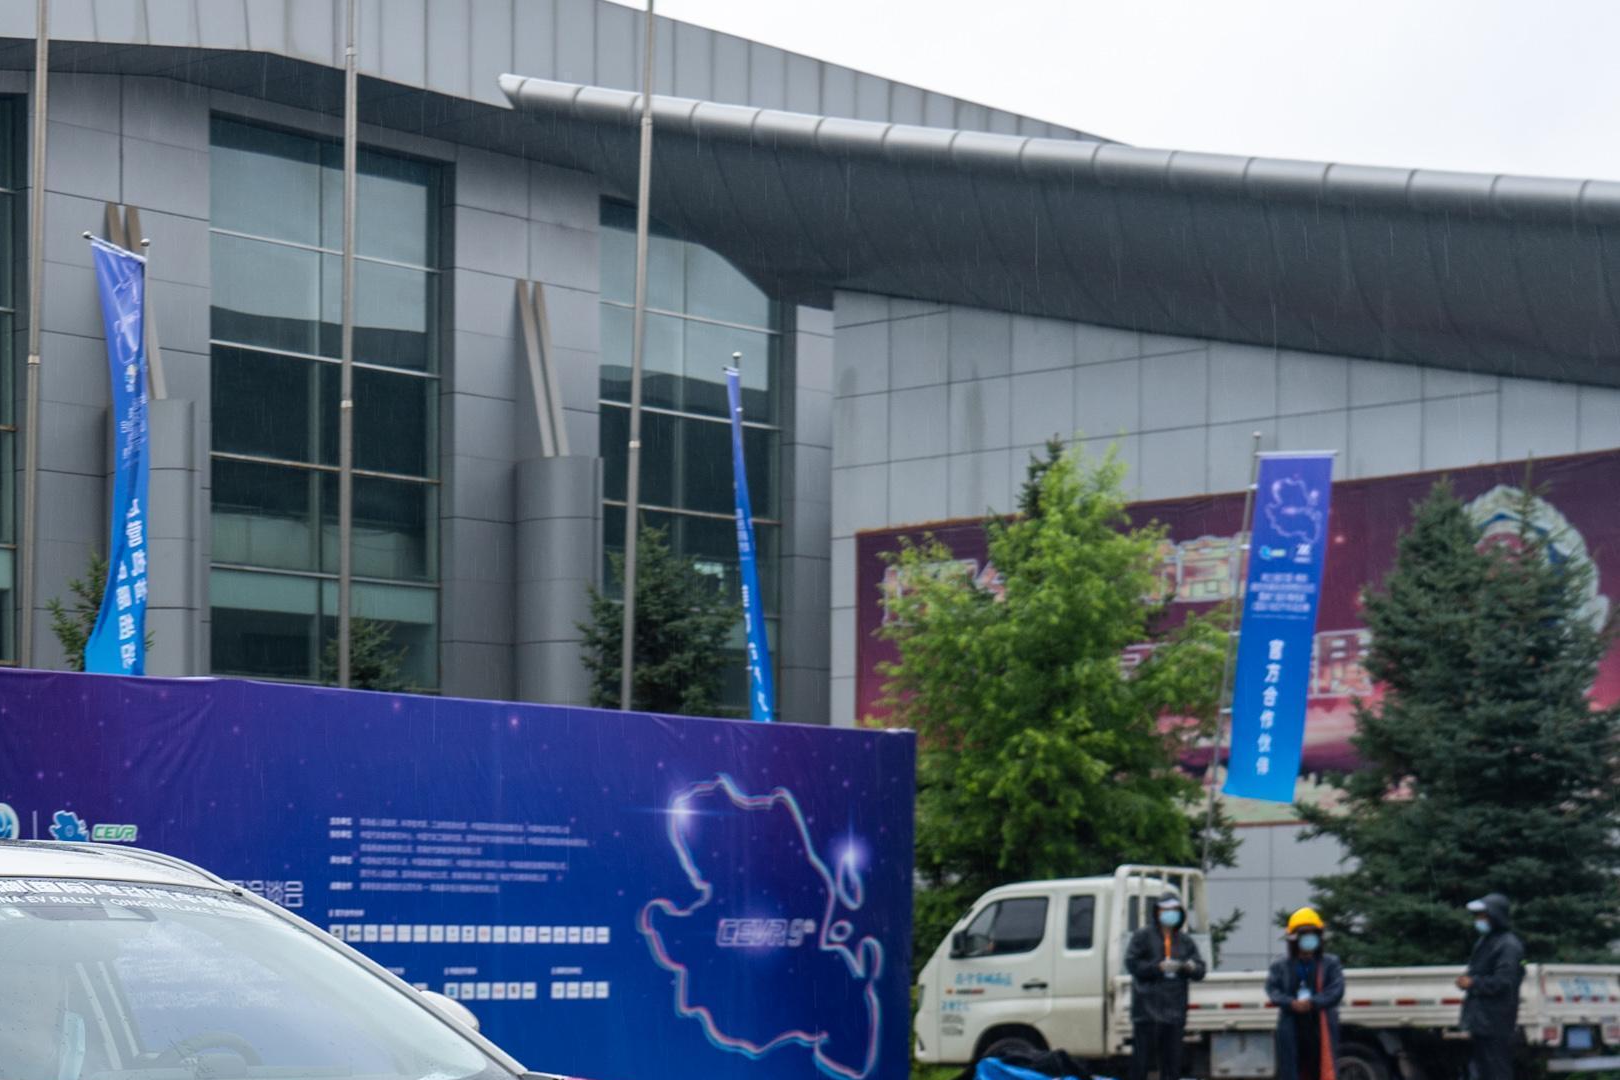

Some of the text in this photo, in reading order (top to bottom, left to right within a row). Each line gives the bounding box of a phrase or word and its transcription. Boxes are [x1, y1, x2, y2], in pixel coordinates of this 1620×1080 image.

[1256, 638, 1285, 776] 官方合作伙伴
[28, 896, 47, 904] EV
[51, 896, 96, 905] RALLY
